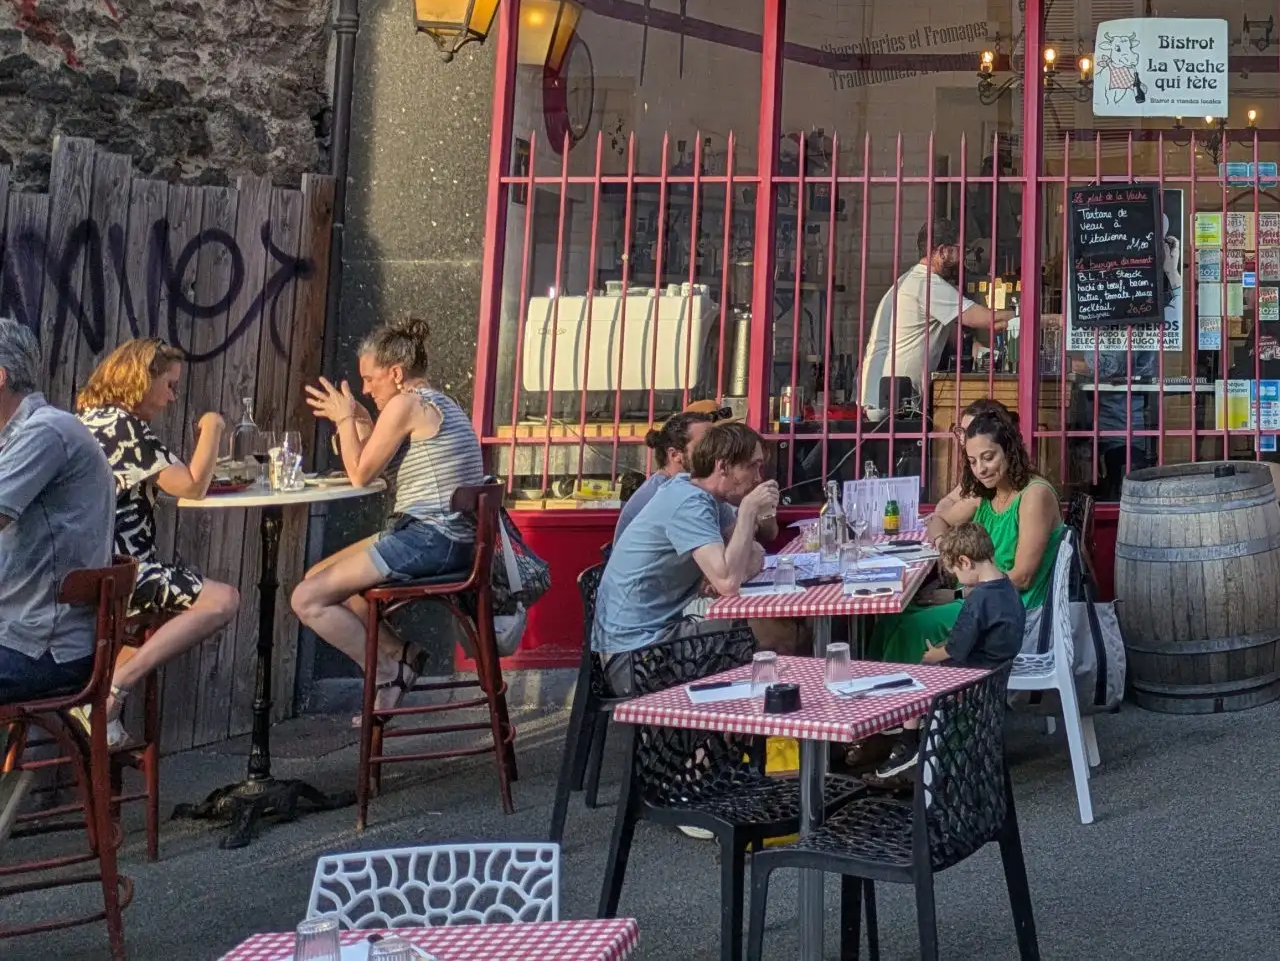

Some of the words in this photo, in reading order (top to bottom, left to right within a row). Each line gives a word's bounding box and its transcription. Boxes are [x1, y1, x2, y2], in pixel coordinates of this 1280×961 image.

[909, 29, 922, 50] et
[924, 21, 989, 48] Fromages
[1158, 35, 1215, 50] Bistrot
[1147, 58, 1168, 73] La
[1173, 58, 1225, 73] Vache
[1155, 76, 1180, 92] qui
[1187, 75, 1217, 89] tète
[1088, 193, 1103, 206] plat
[1105, 192, 1114, 201] de
[1115, 191, 1123, 201] la
[1126, 190, 1148, 201] Vache
[1077, 208, 1112, 220] Tartare
[1118, 208, 1128, 218] de
[1080, 222, 1104, 231] veau
[1114, 219, 1121, 228] à
[1097, 282, 1105, 291] de
[1259, 307, 1279, 315] 2025
